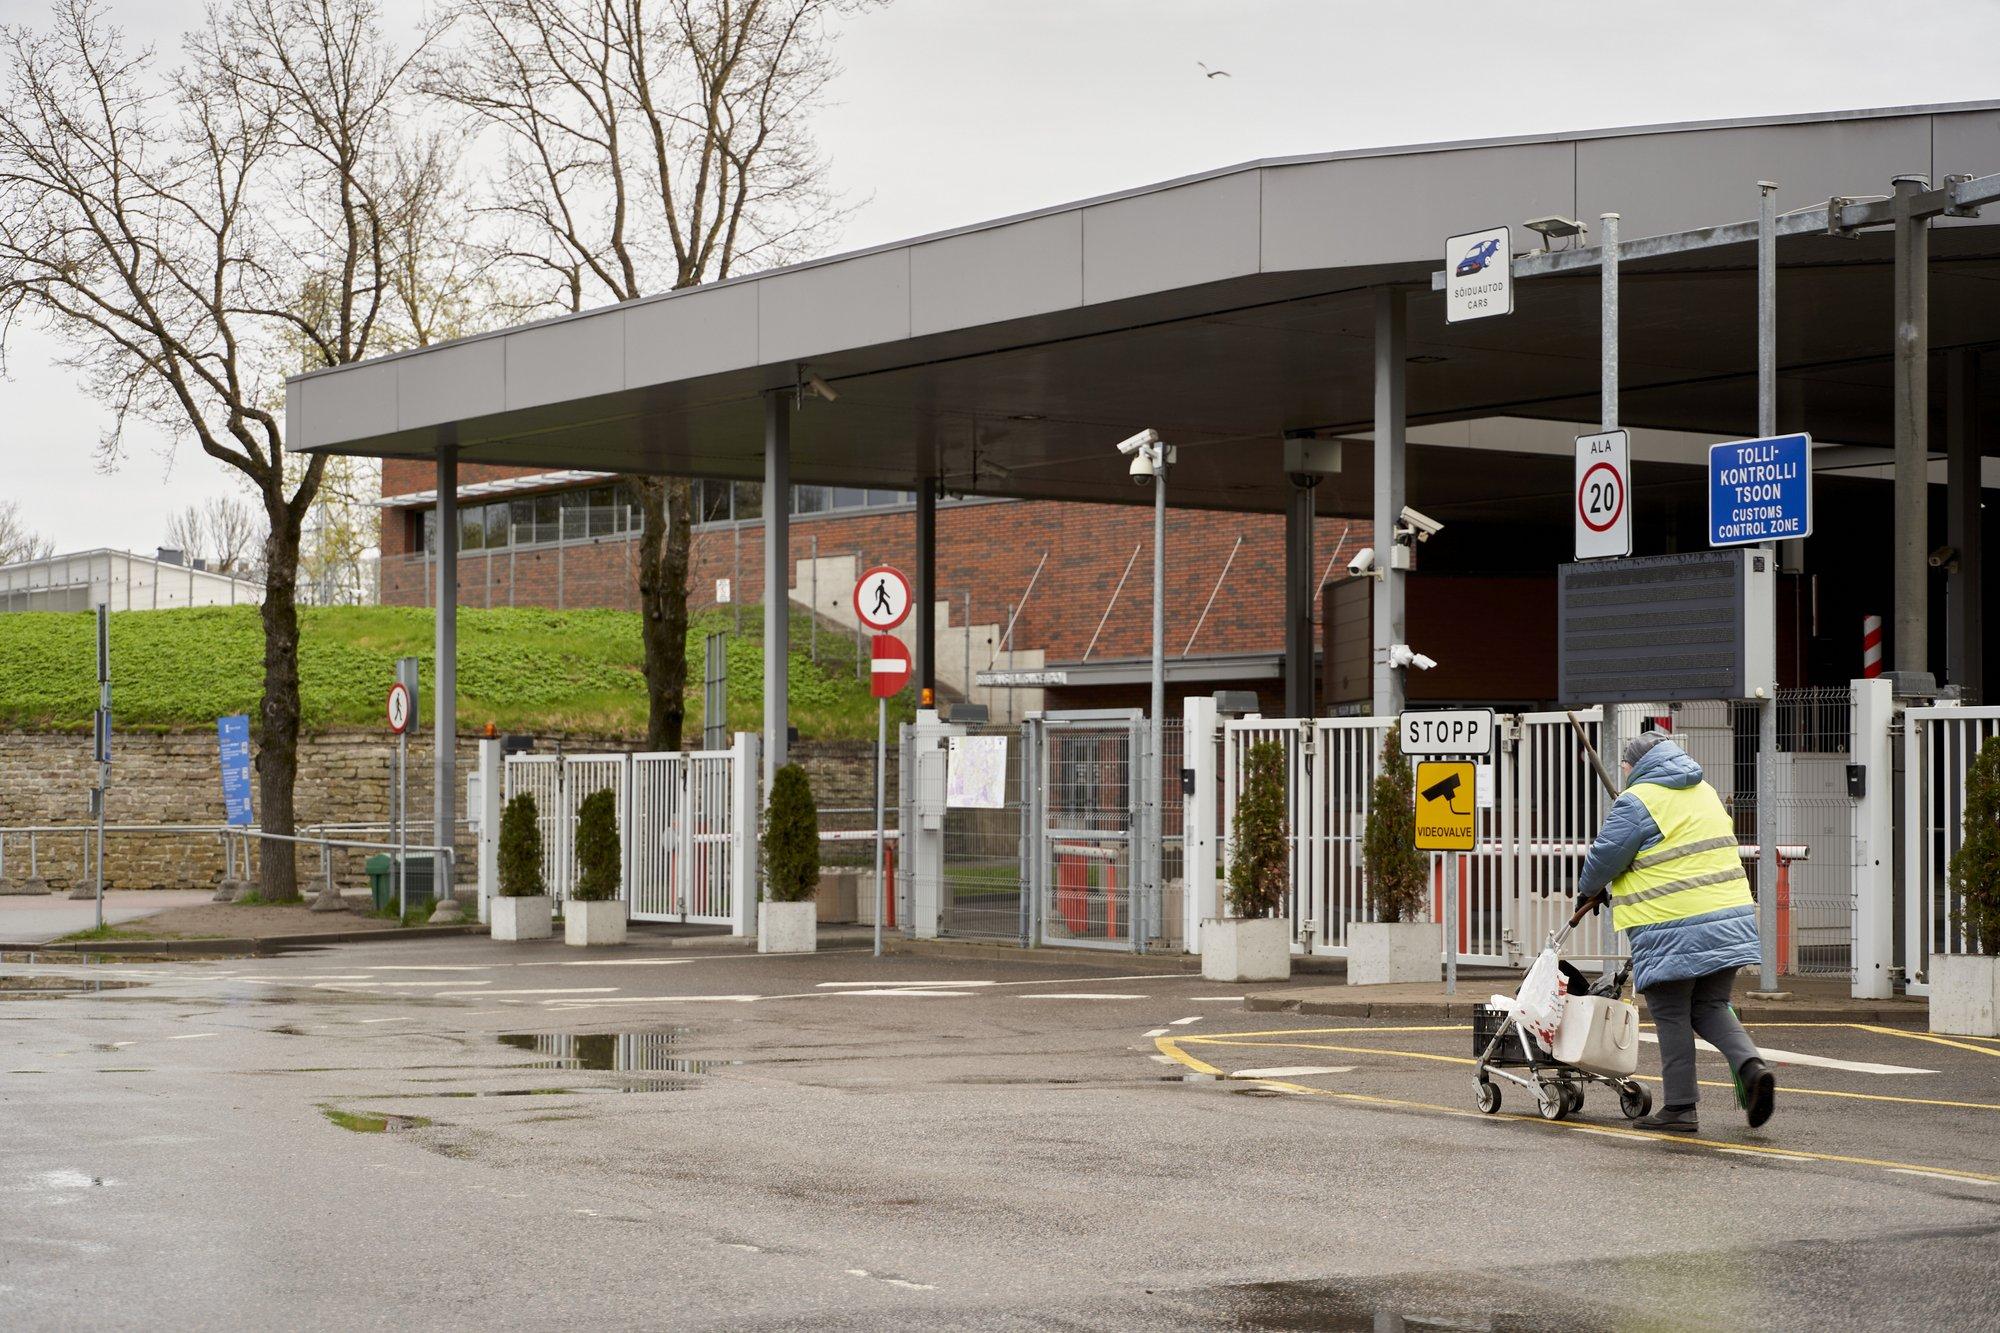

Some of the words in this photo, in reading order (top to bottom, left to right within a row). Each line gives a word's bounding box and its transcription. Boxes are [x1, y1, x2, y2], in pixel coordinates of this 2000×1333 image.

[1454, 282, 1503, 298] SÕIDUAUTOD
[1467, 298, 1488, 310] CARS
[1590, 439, 1612, 454] ALA
[1737, 445, 1779, 465] TOLLI-
[1720, 462, 1796, 486] KONTROLLI
[1589, 482, 1614, 513] 20
[1735, 483, 1781, 503] TSOON
[1732, 505, 1783, 522] CUSTOMS
[1718, 522, 1767, 538] CONTROL
[1770, 518, 1799, 533] ZONE
[1409, 720, 1478, 743] STOPP
[1417, 826, 1472, 838] VIDEOVALVE
